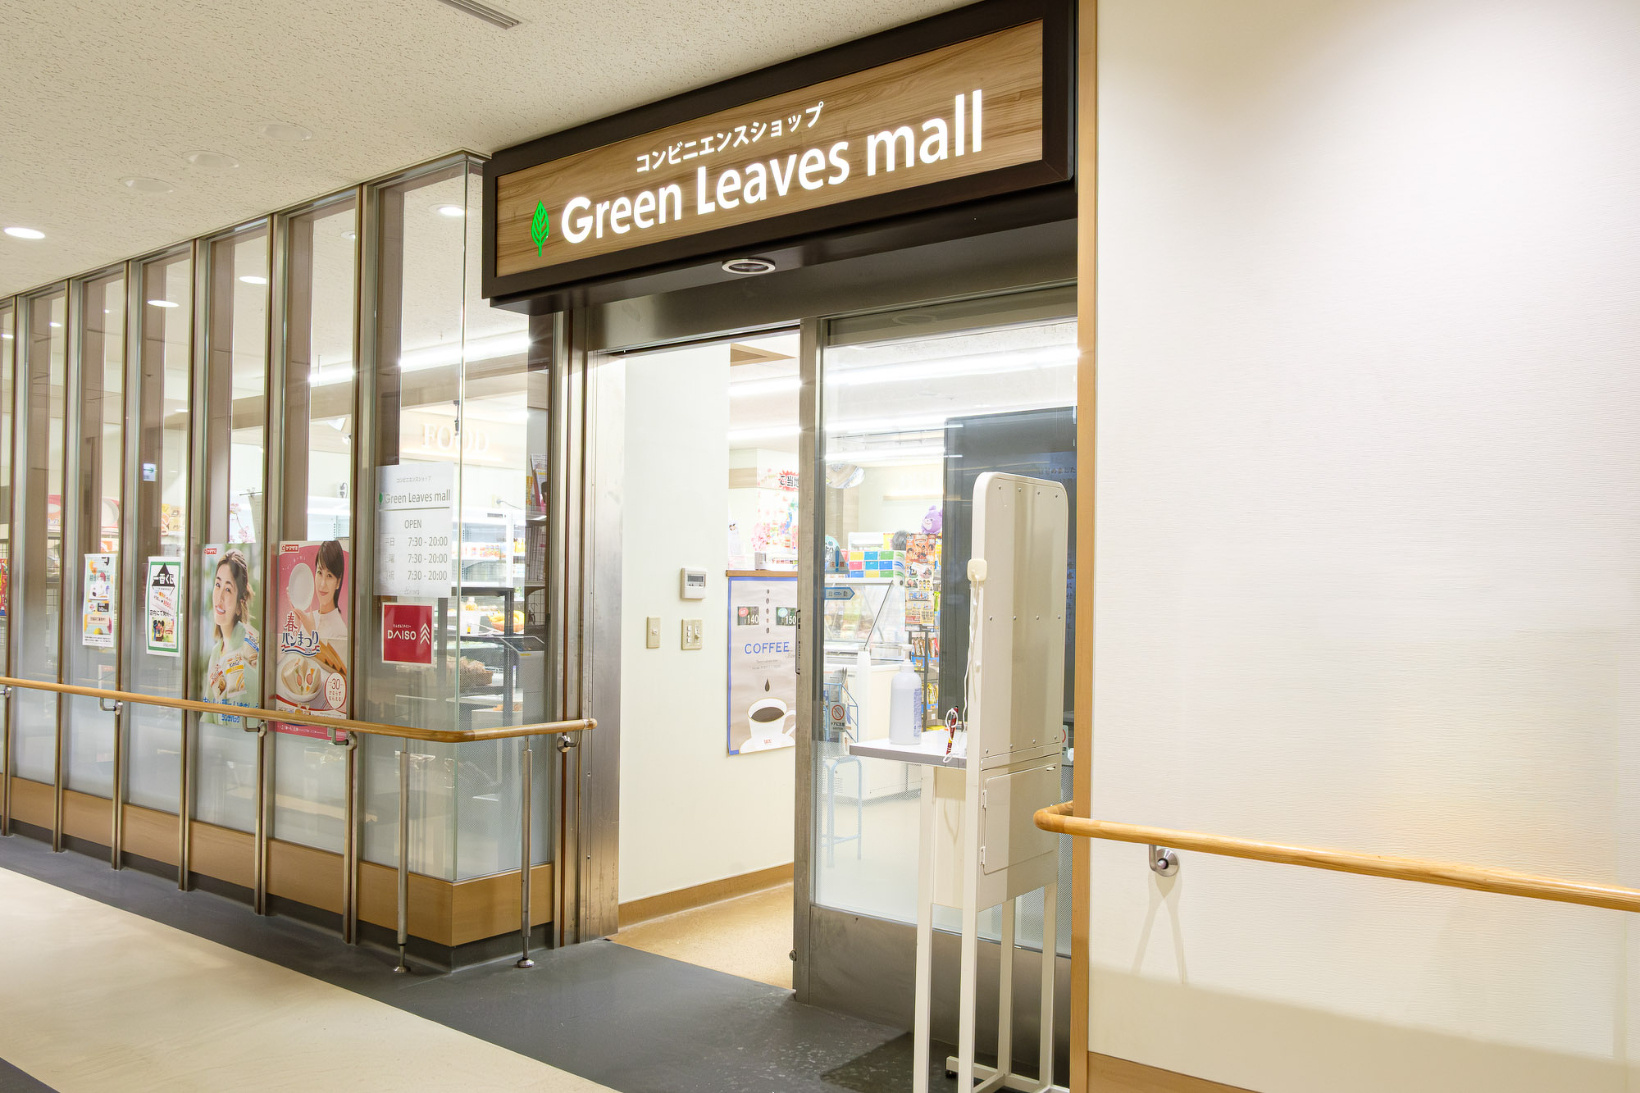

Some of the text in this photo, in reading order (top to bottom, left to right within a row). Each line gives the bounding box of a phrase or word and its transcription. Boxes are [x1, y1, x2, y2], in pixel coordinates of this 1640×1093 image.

[636, 101, 825, 174] コンビニエンスショップ
[561, 89, 984, 245] Green Leaves mall
[421, 423, 489, 452] FOOD
[385, 488, 451, 504] Green Leaves mall
[404, 520, 422, 529] OPEN
[407, 536, 422, 547] 7:30
[428, 536, 448, 546] 20:00
[407, 553, 422, 564] 7:30
[428, 553, 448, 564] 20:00
[407, 570, 422, 580] 7:30
[428, 570, 448, 580] 20:00
[747, 614, 758, 624] 140
[786, 615, 796, 624] 150
[387, 629, 417, 641] DAISO
[744, 641, 790, 655] COFFEE
